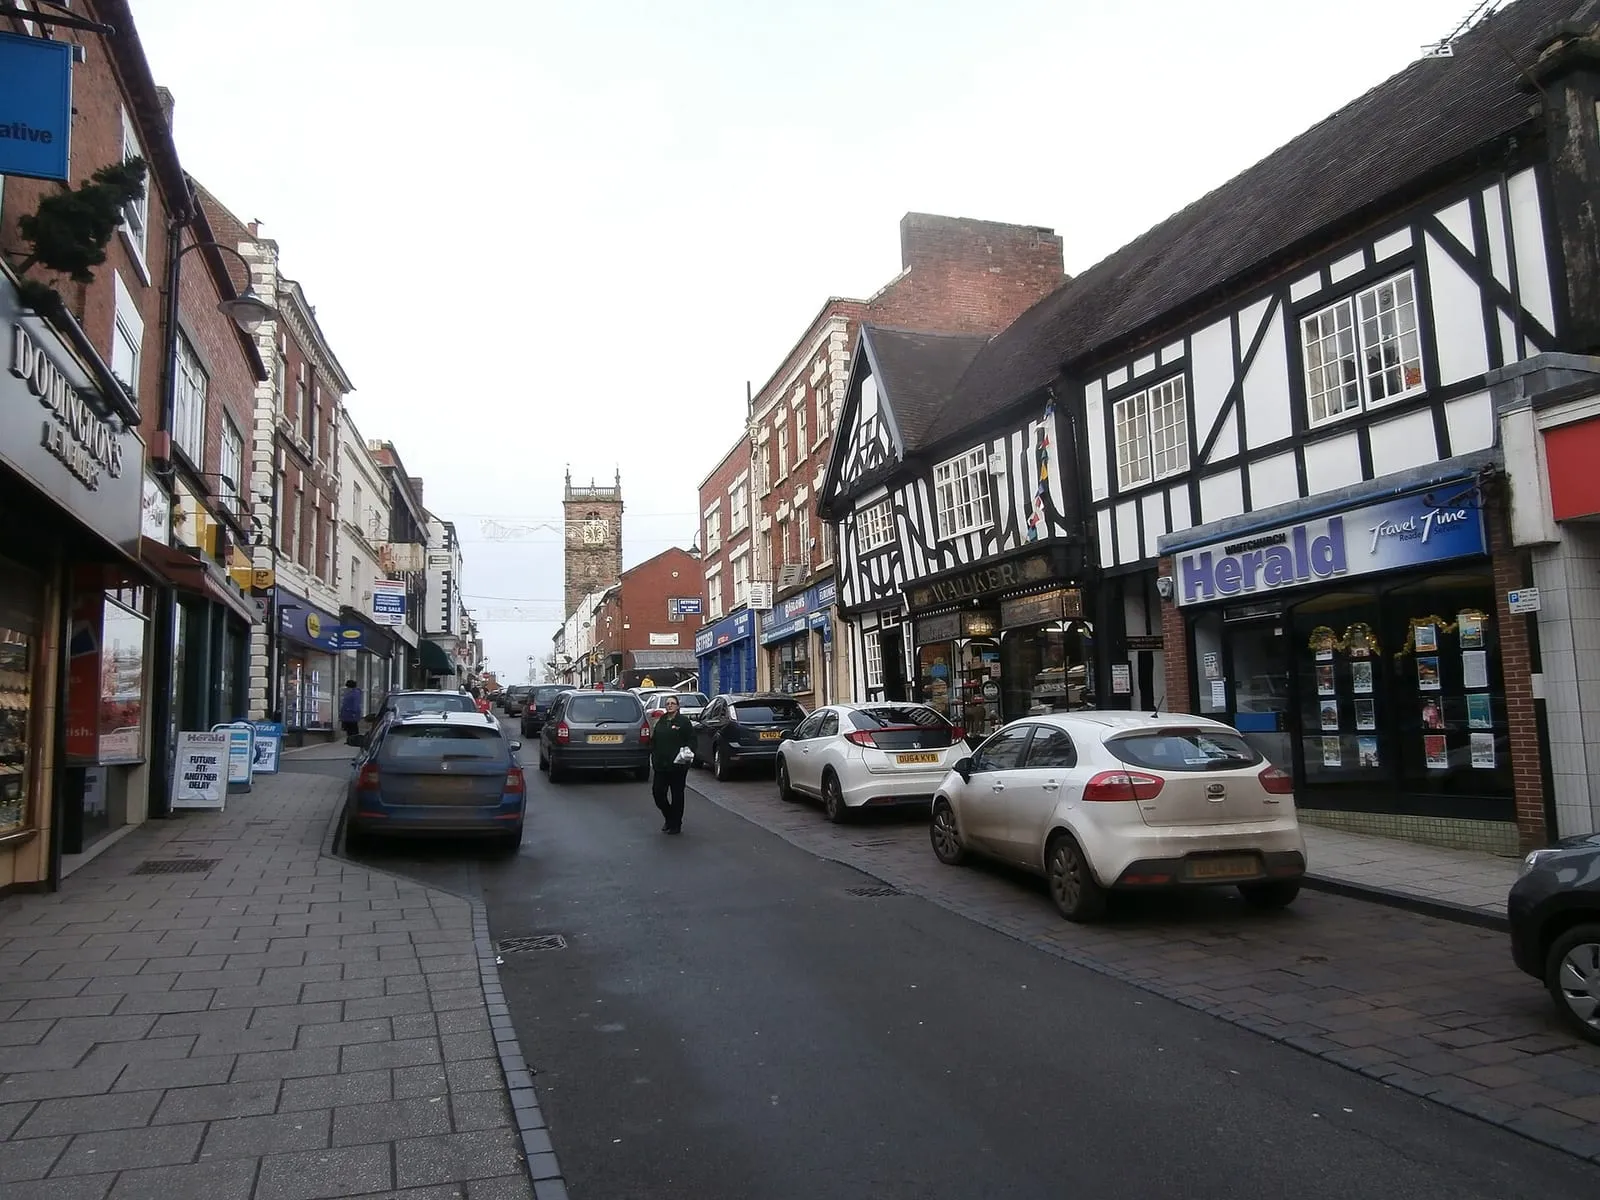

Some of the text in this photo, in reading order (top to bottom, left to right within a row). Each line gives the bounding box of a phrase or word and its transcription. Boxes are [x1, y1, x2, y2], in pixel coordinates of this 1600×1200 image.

[1369, 508, 1467, 554] Travel Time
[1224, 532, 1287, 556] WHITCHURCH
[1182, 516, 1348, 602] Herald
[695, 630, 714, 654] BETFRED
[190, 755, 217, 765] FUTURE
[899, 754, 937, 763] DU64 KYB
[184, 772, 217, 782] ANOTHER
[188, 781, 210, 789] DELAY
